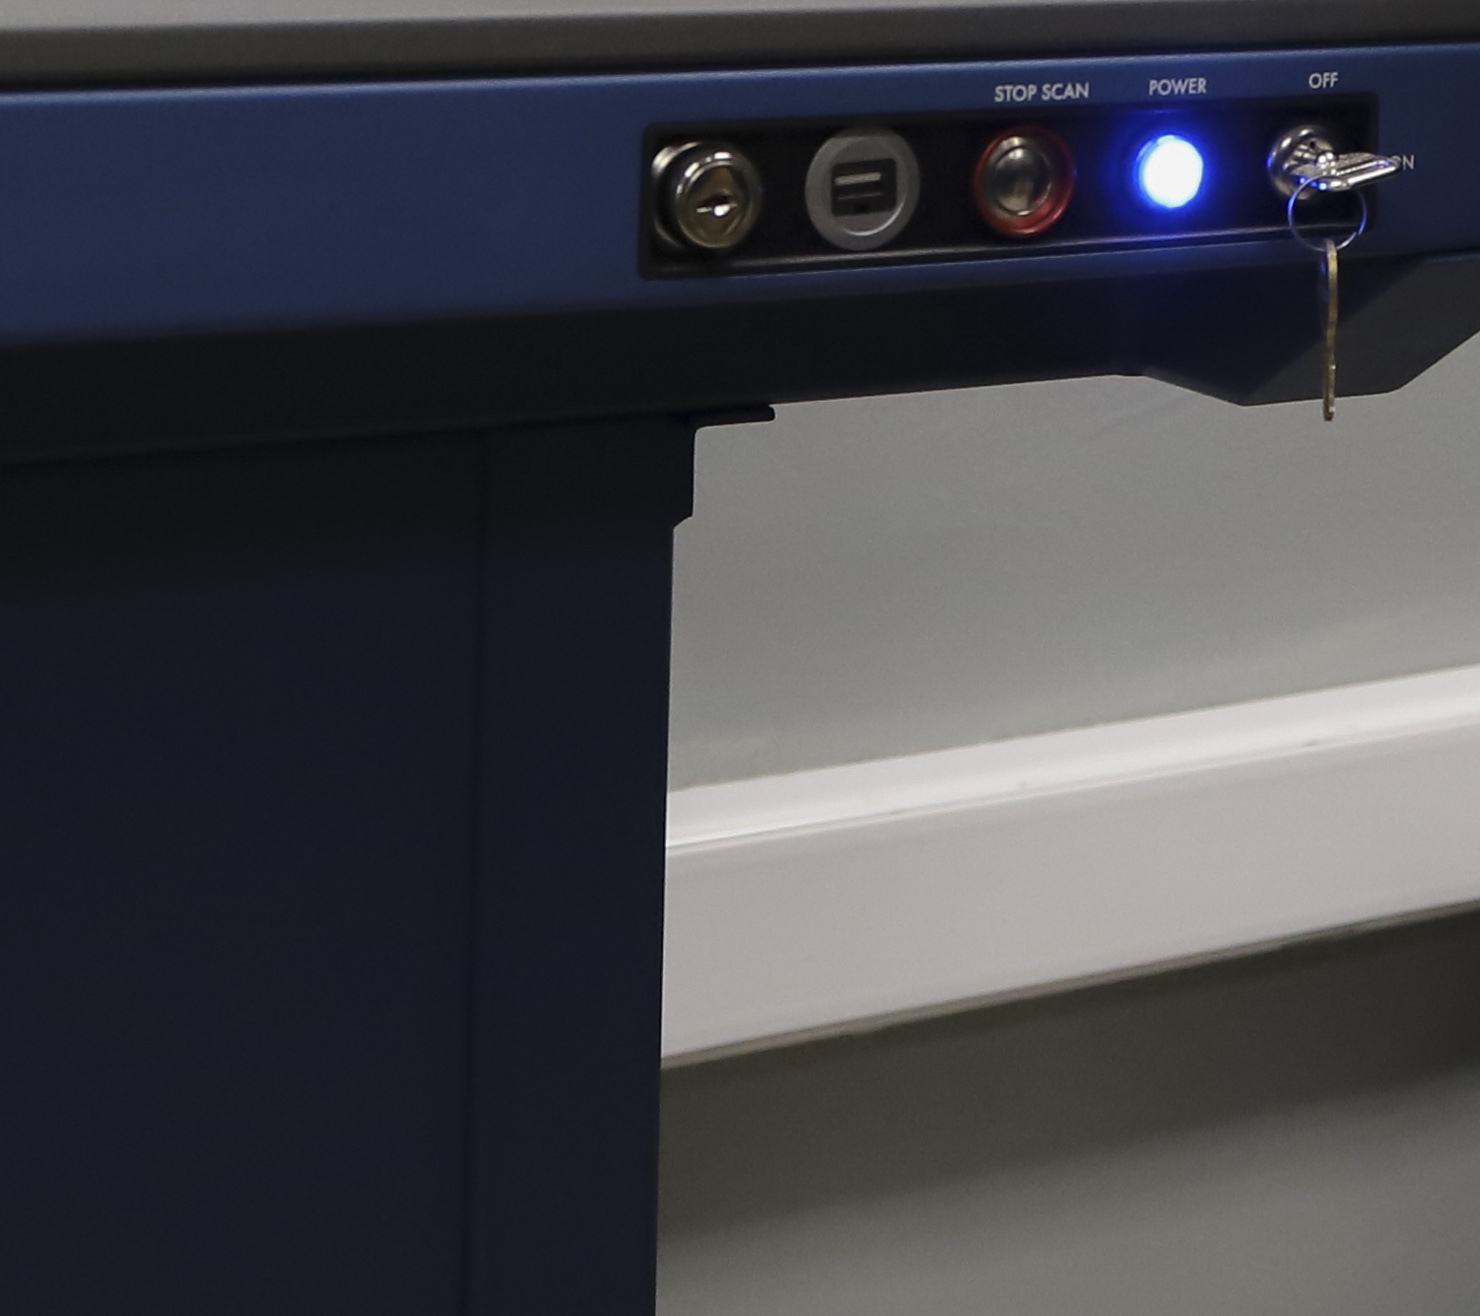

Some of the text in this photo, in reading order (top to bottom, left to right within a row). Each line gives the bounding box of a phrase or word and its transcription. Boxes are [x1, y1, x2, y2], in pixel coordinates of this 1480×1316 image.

[1149, 77, 1207, 96] POWER
[1308, 72, 1339, 89] OFF
[994, 83, 1090, 103] STOP SCAN
